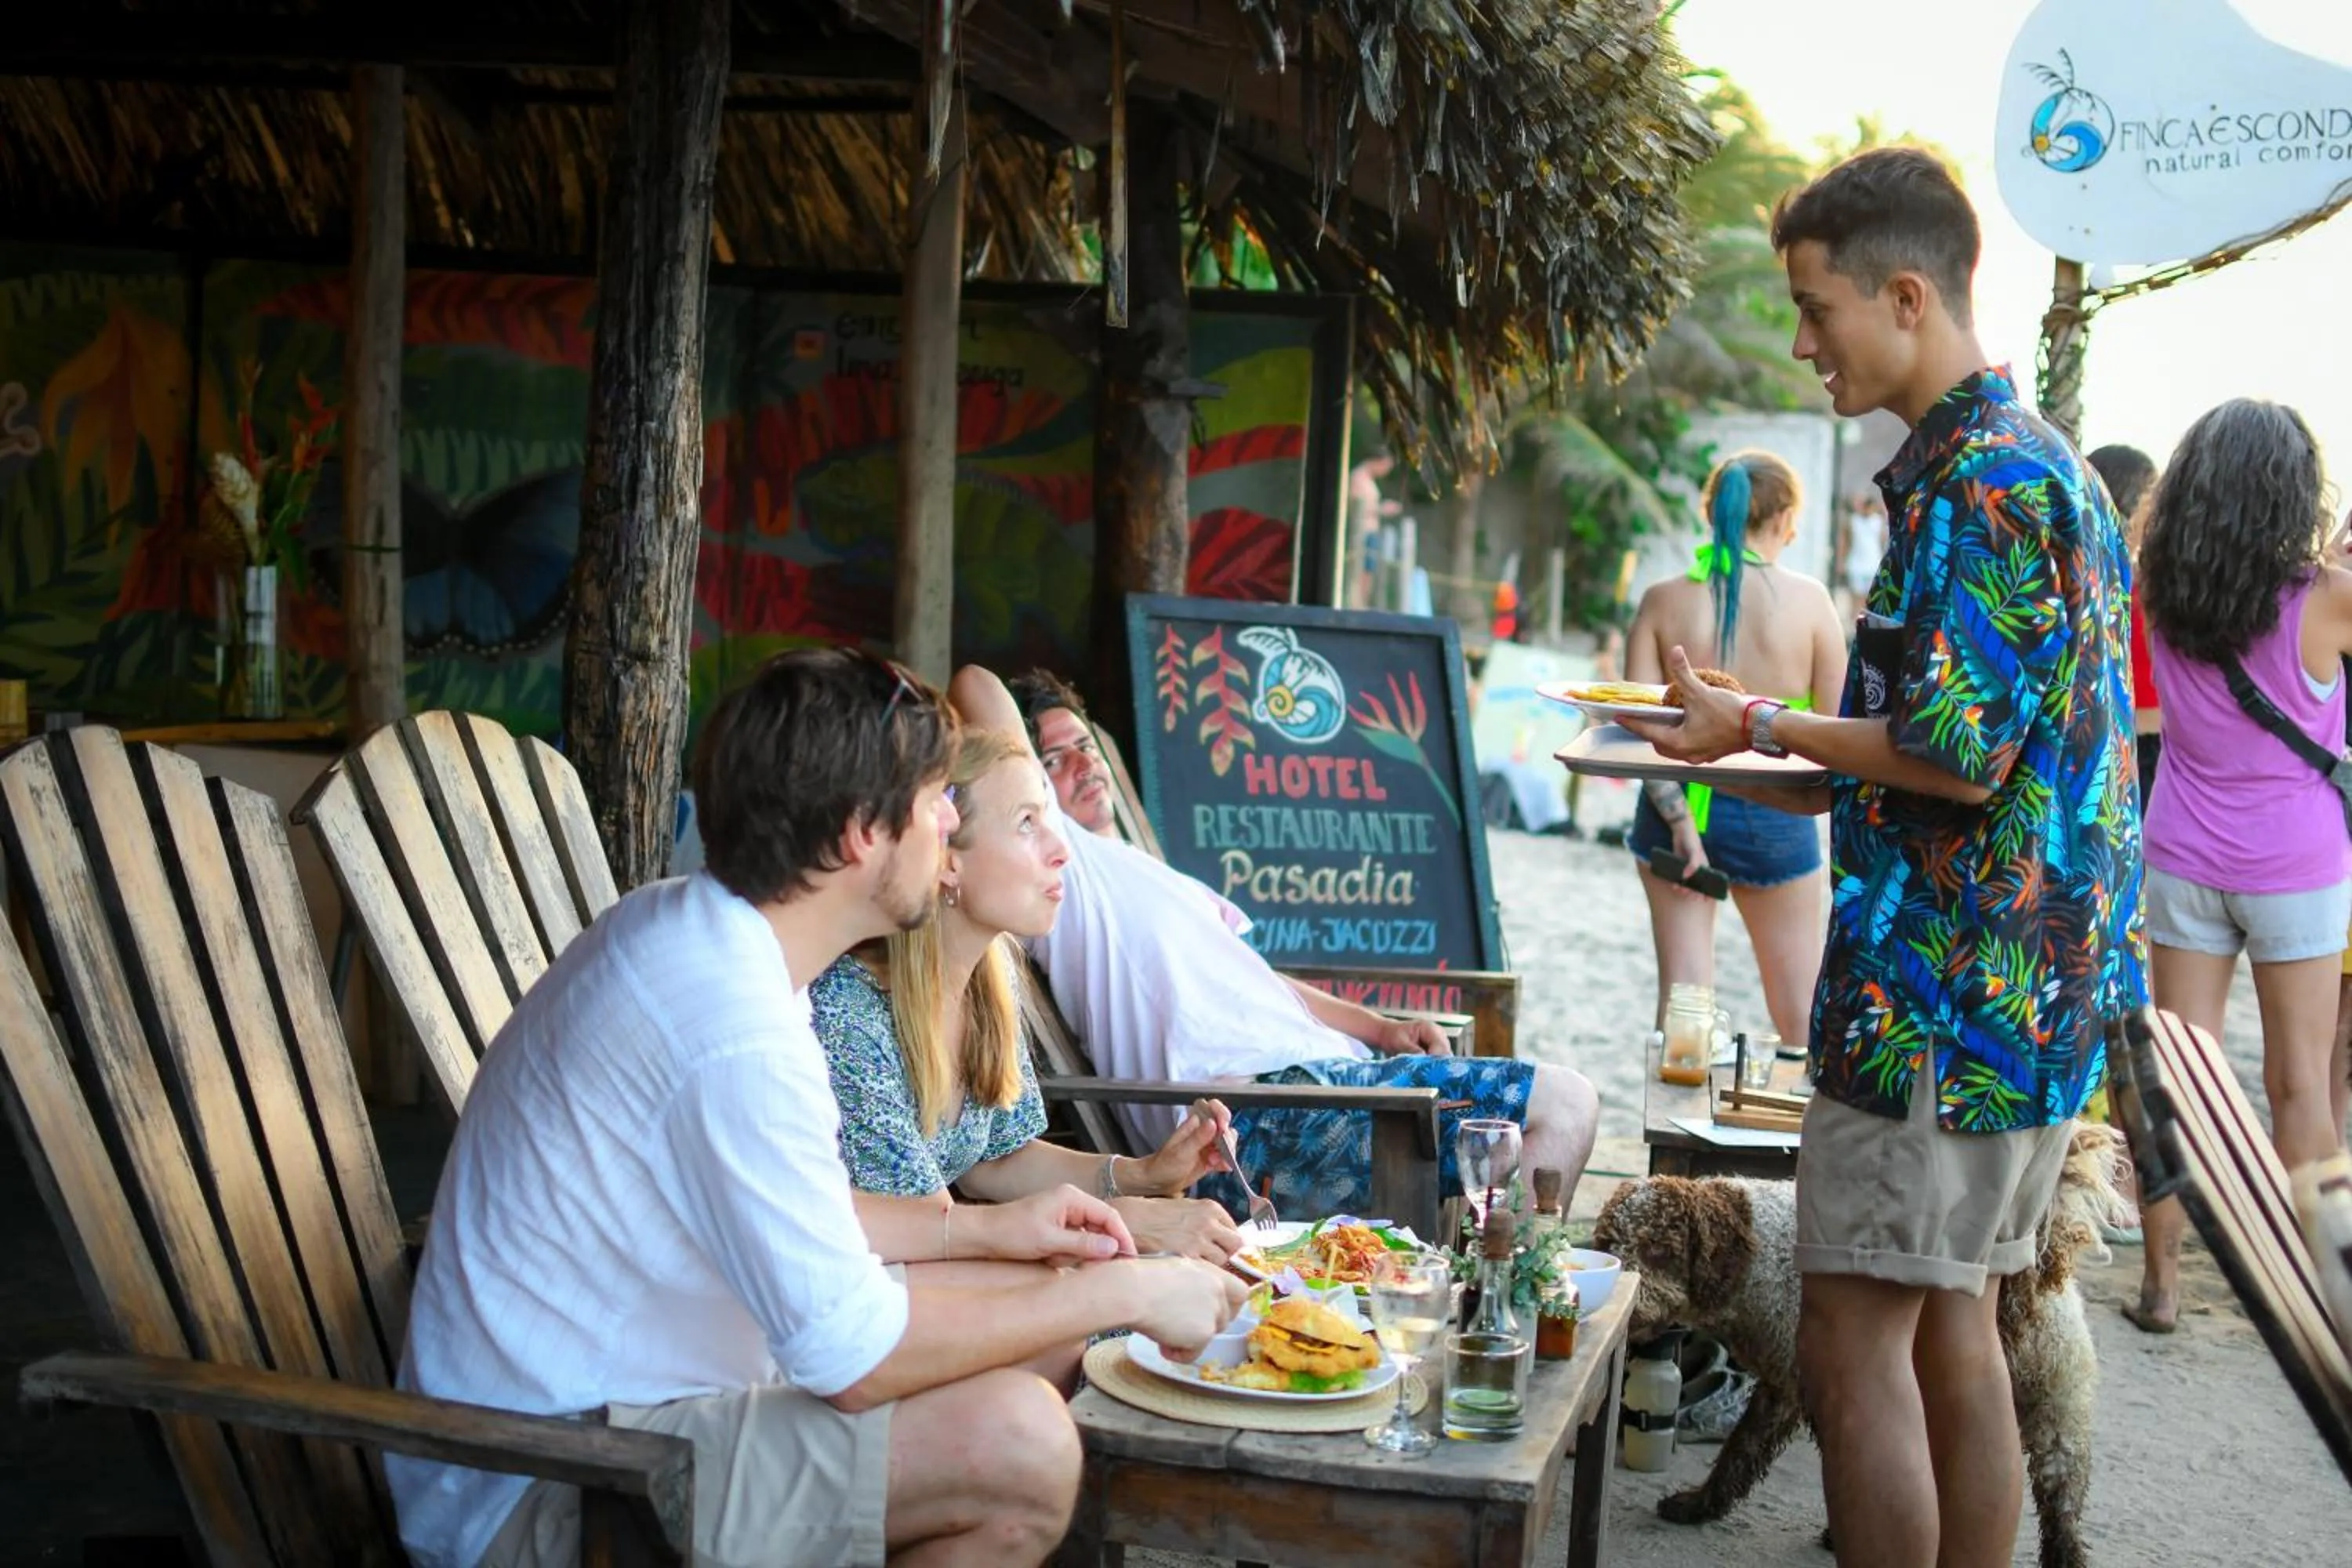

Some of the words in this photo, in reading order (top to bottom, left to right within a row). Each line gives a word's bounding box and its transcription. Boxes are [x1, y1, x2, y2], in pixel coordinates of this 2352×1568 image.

[2145, 147, 2241, 174] natural
[1243, 753, 1387, 800] HOTEL
[1193, 804, 1438, 854] RESTAURANTE
[1247, 916, 1437, 955] CINA-JACUZZI
